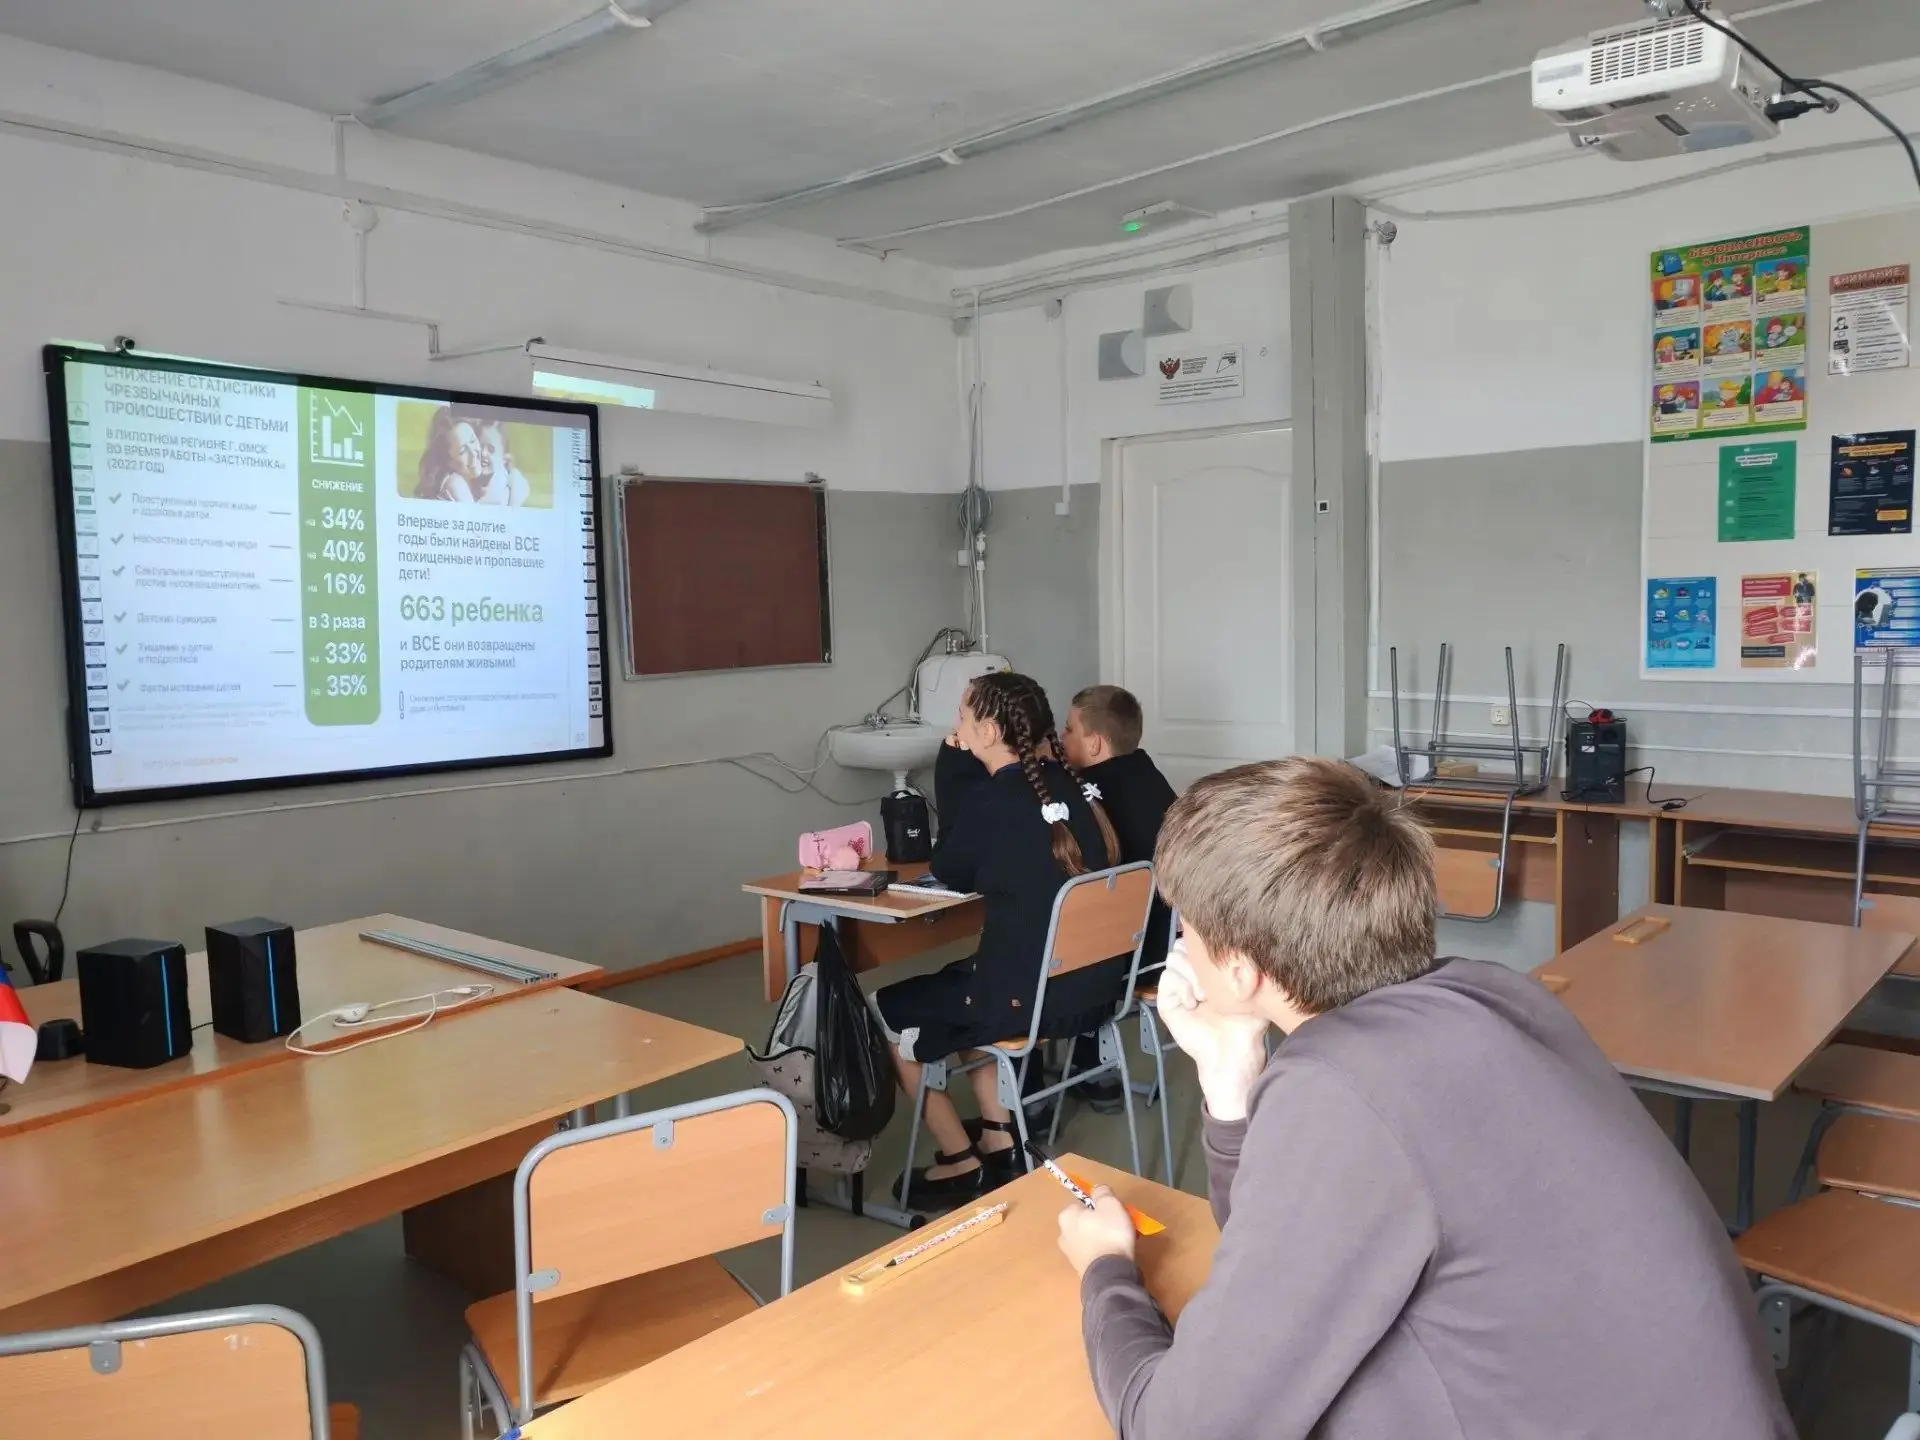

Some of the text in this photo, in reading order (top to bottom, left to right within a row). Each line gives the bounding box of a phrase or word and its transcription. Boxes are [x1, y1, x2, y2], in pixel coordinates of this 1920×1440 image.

[104, 366, 276, 398] СНИЖЕНИЕ СТАТИСТИКИ
[104, 383, 221, 409] ЧРЕЗВЫЧАЙНЫХ
[104, 401, 289, 433] ПРОИСШЕСТВИЙ С ДЕТЬМИ
[115, 429, 179, 446] ПИЛОТНОМ
[180, 437, 227, 451] РЕГИОНЕ
[238, 442, 269, 454] ОМСК
[107, 443, 122, 454] ВО
[125, 445, 161, 457] ВРЕМЯ
[162, 448, 206, 463] РАБОТЫ
[311, 478, 365, 493] СНИЖЕНИЕ
[321, 506, 365, 531] 34%
[397, 513, 506, 534] Впервые за долгие
[322, 539, 366, 563] 40%
[398, 532, 540, 552] годы были найдены ВСЕ
[398, 551, 545, 569] похищенные и пропавшие
[323, 572, 366, 595] 16%
[398, 567, 431, 581] дети!
[400, 594, 544, 627] 663 ребенка
[320, 612, 330, 629] 3
[333, 616, 366, 632] раза
[325, 642, 367, 664] 33%
[400, 635, 536, 654] и ВСЕ они возвращены
[400, 656, 516, 672] родителям живыми!
[326, 674, 368, 697] 35%
